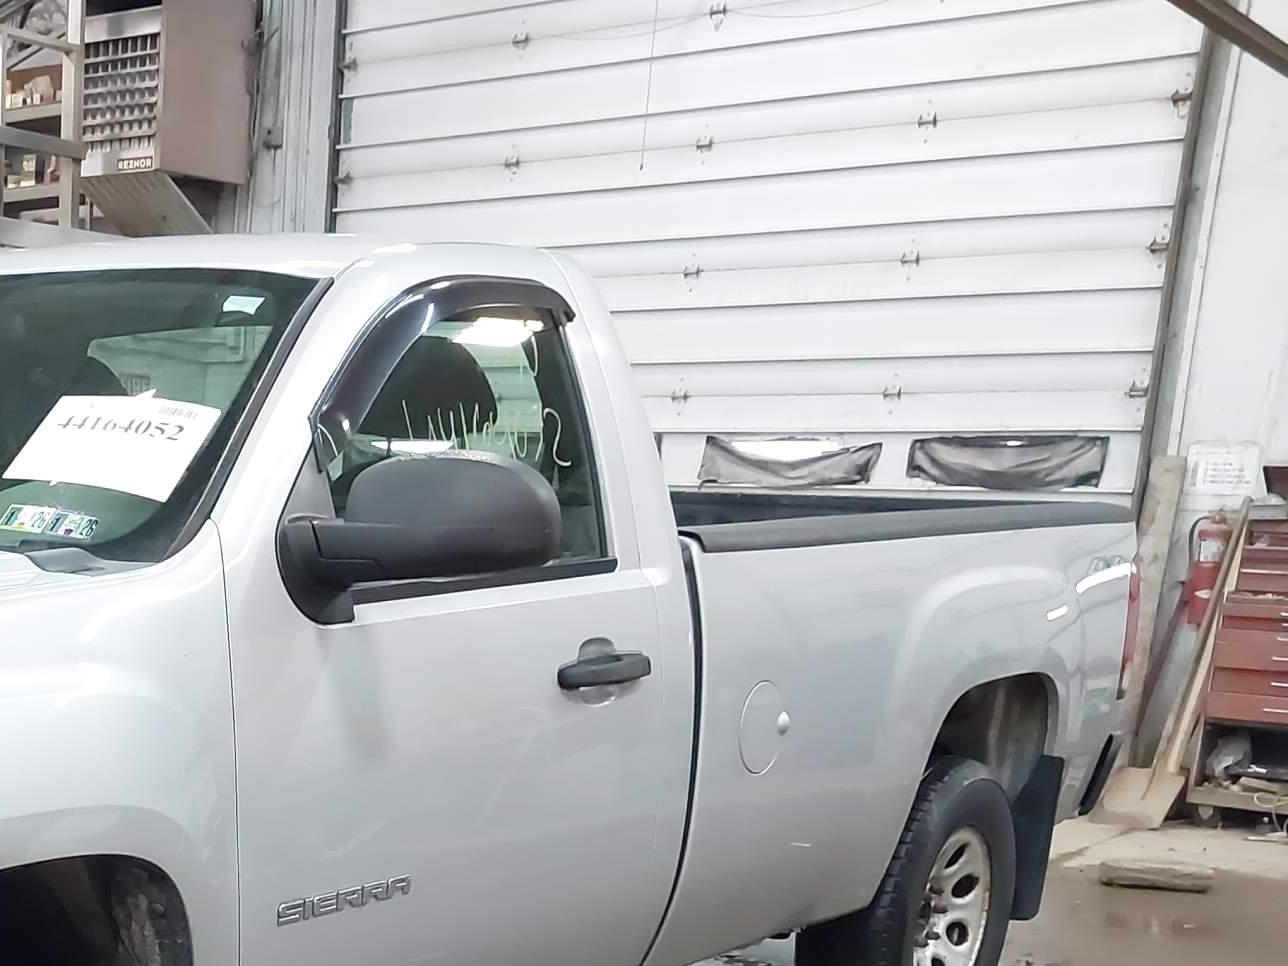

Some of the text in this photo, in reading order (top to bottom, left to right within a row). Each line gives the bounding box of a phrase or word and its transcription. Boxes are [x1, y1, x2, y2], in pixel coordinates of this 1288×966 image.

[118, 158, 152, 169] REZNOR
[58, 416, 185, 441] 44164052
[79, 519, 98, 537] 26
[277, 874, 411, 927] SIERRA
